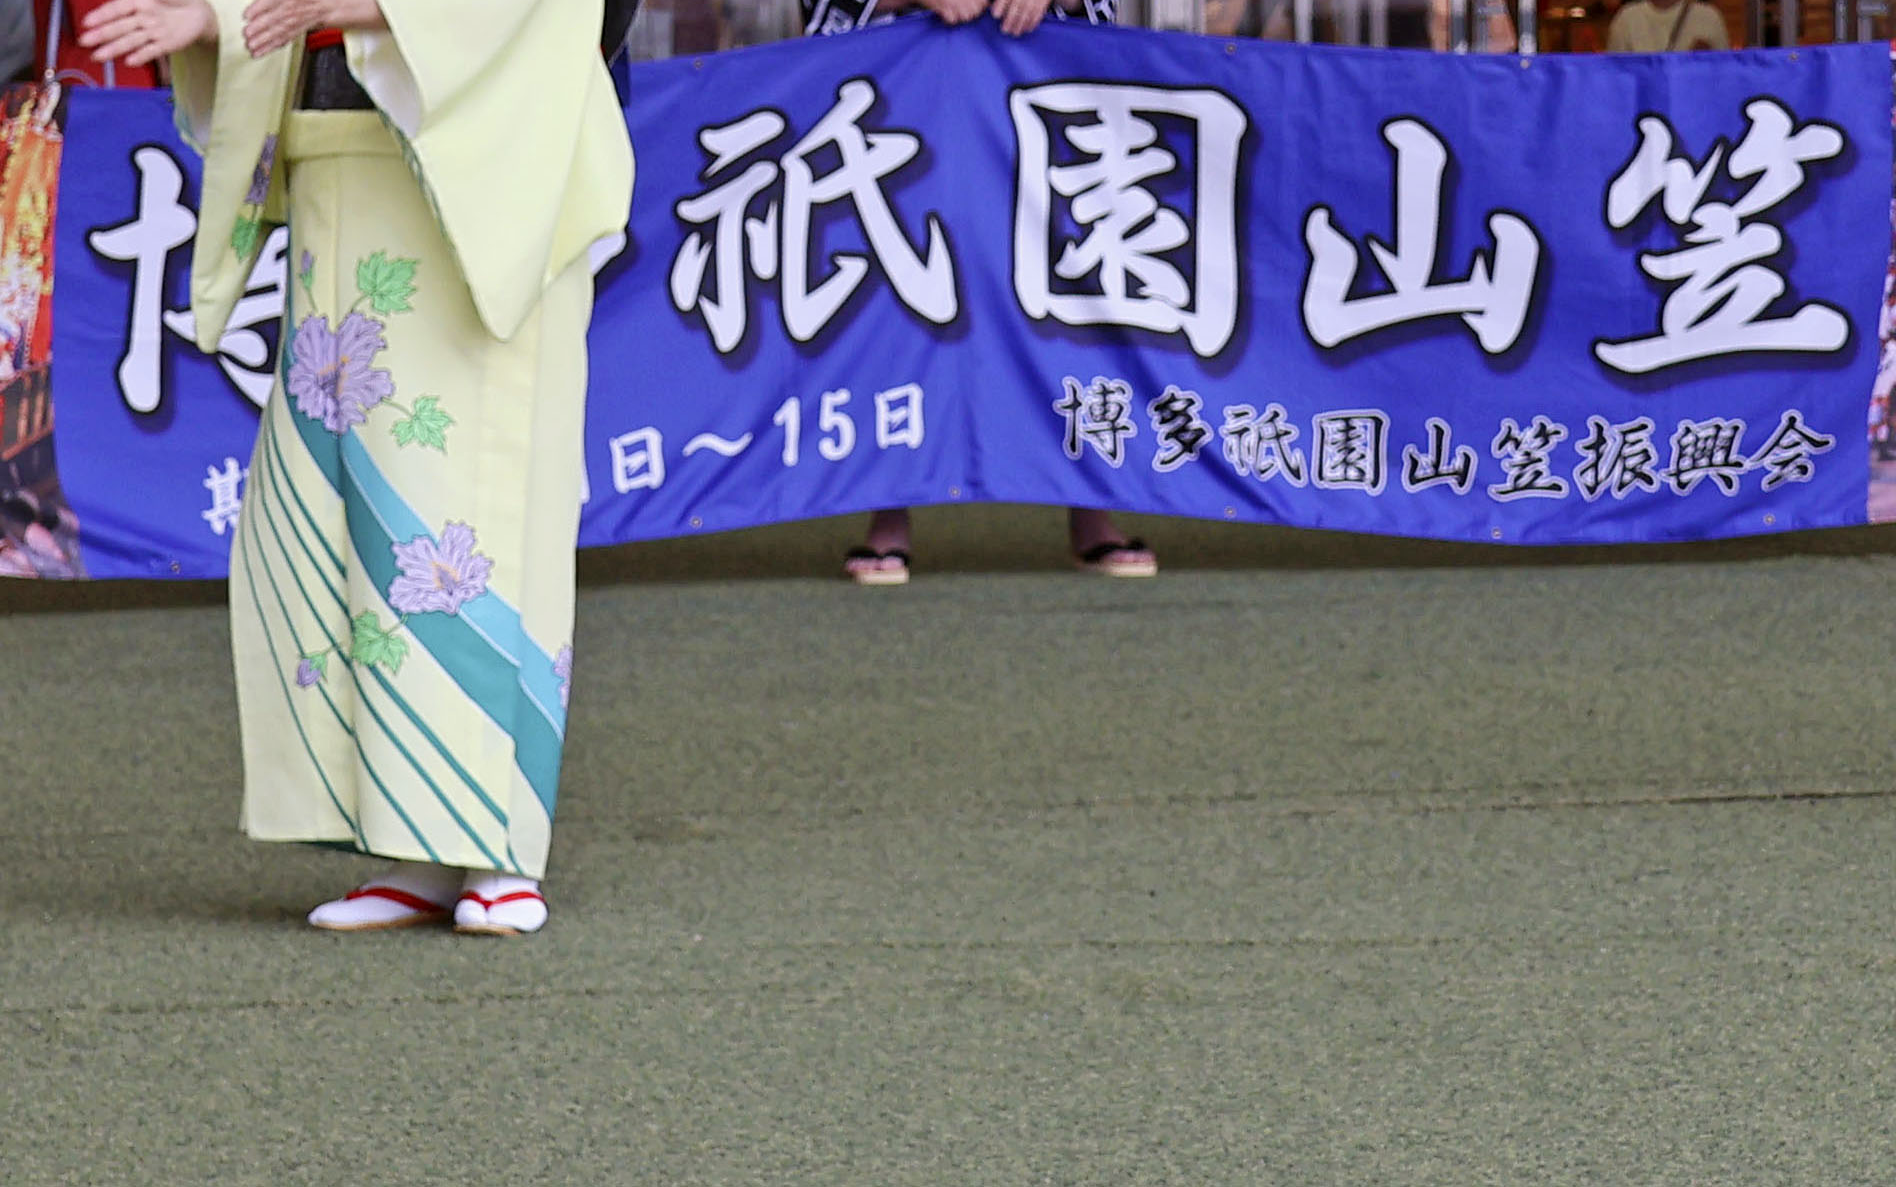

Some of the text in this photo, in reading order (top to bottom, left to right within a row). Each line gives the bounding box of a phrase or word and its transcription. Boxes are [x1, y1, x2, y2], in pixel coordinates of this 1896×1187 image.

[88, 78, 1852, 414] 祇園山笠
[580, 382, 926, 505] 日～15日
[1054, 376, 1835, 500] 博多祇園山笠振興会
